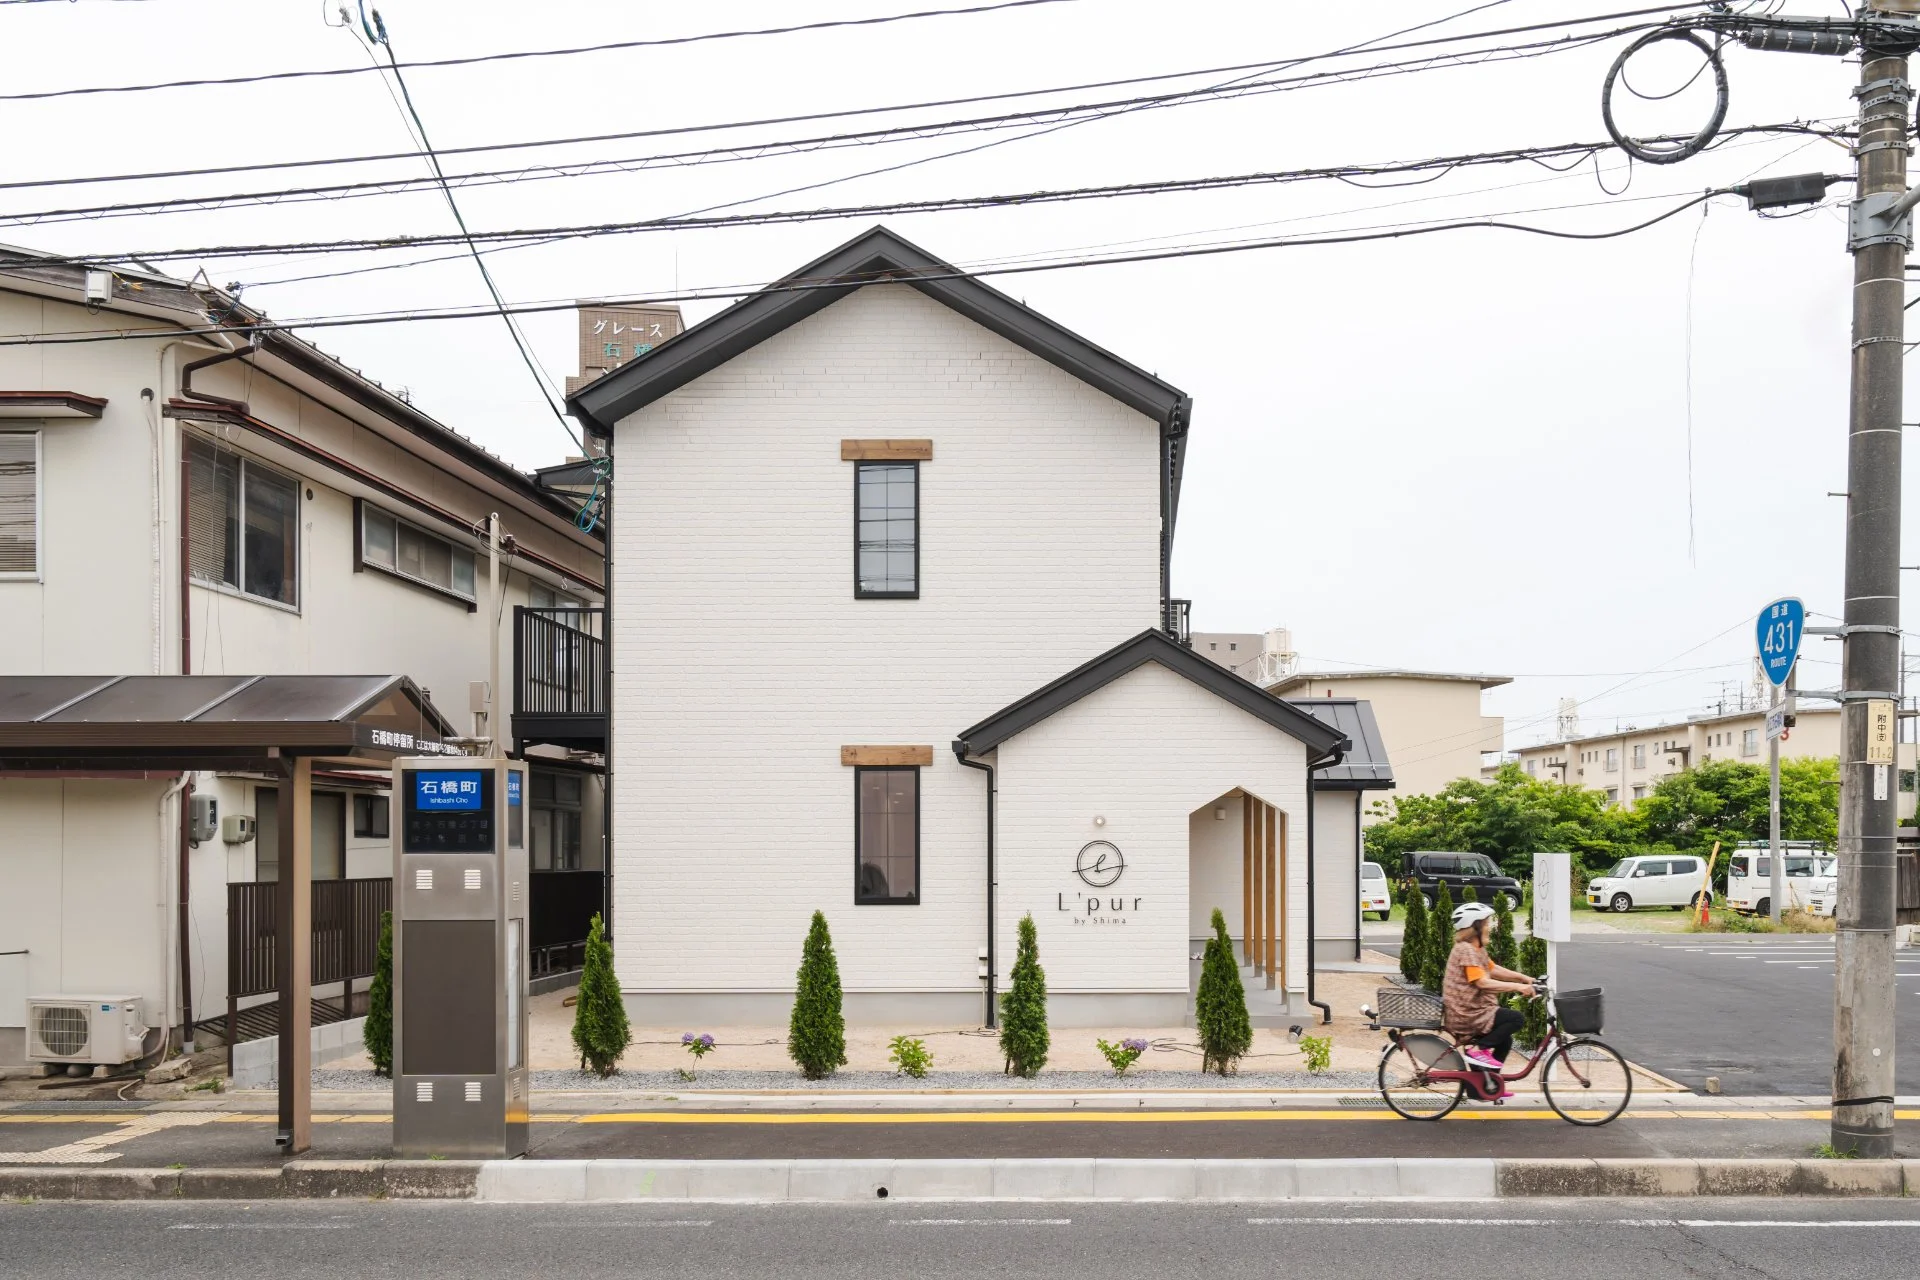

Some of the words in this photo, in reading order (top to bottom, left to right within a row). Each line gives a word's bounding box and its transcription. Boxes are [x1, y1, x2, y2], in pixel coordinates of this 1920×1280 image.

[594, 320, 662, 337] グレース
[1771, 603, 1788, 618] 国道
[1763, 620, 1794, 654] 431
[1770, 656, 1787, 668] ROUTE
[371, 729, 414, 749] 石橋町停留所
[420, 781, 478, 794] 石橋町
[1058, 892, 1142, 916] L'pur
[1074, 916, 1086, 926] by
[1093, 917, 1127, 925] Shima
